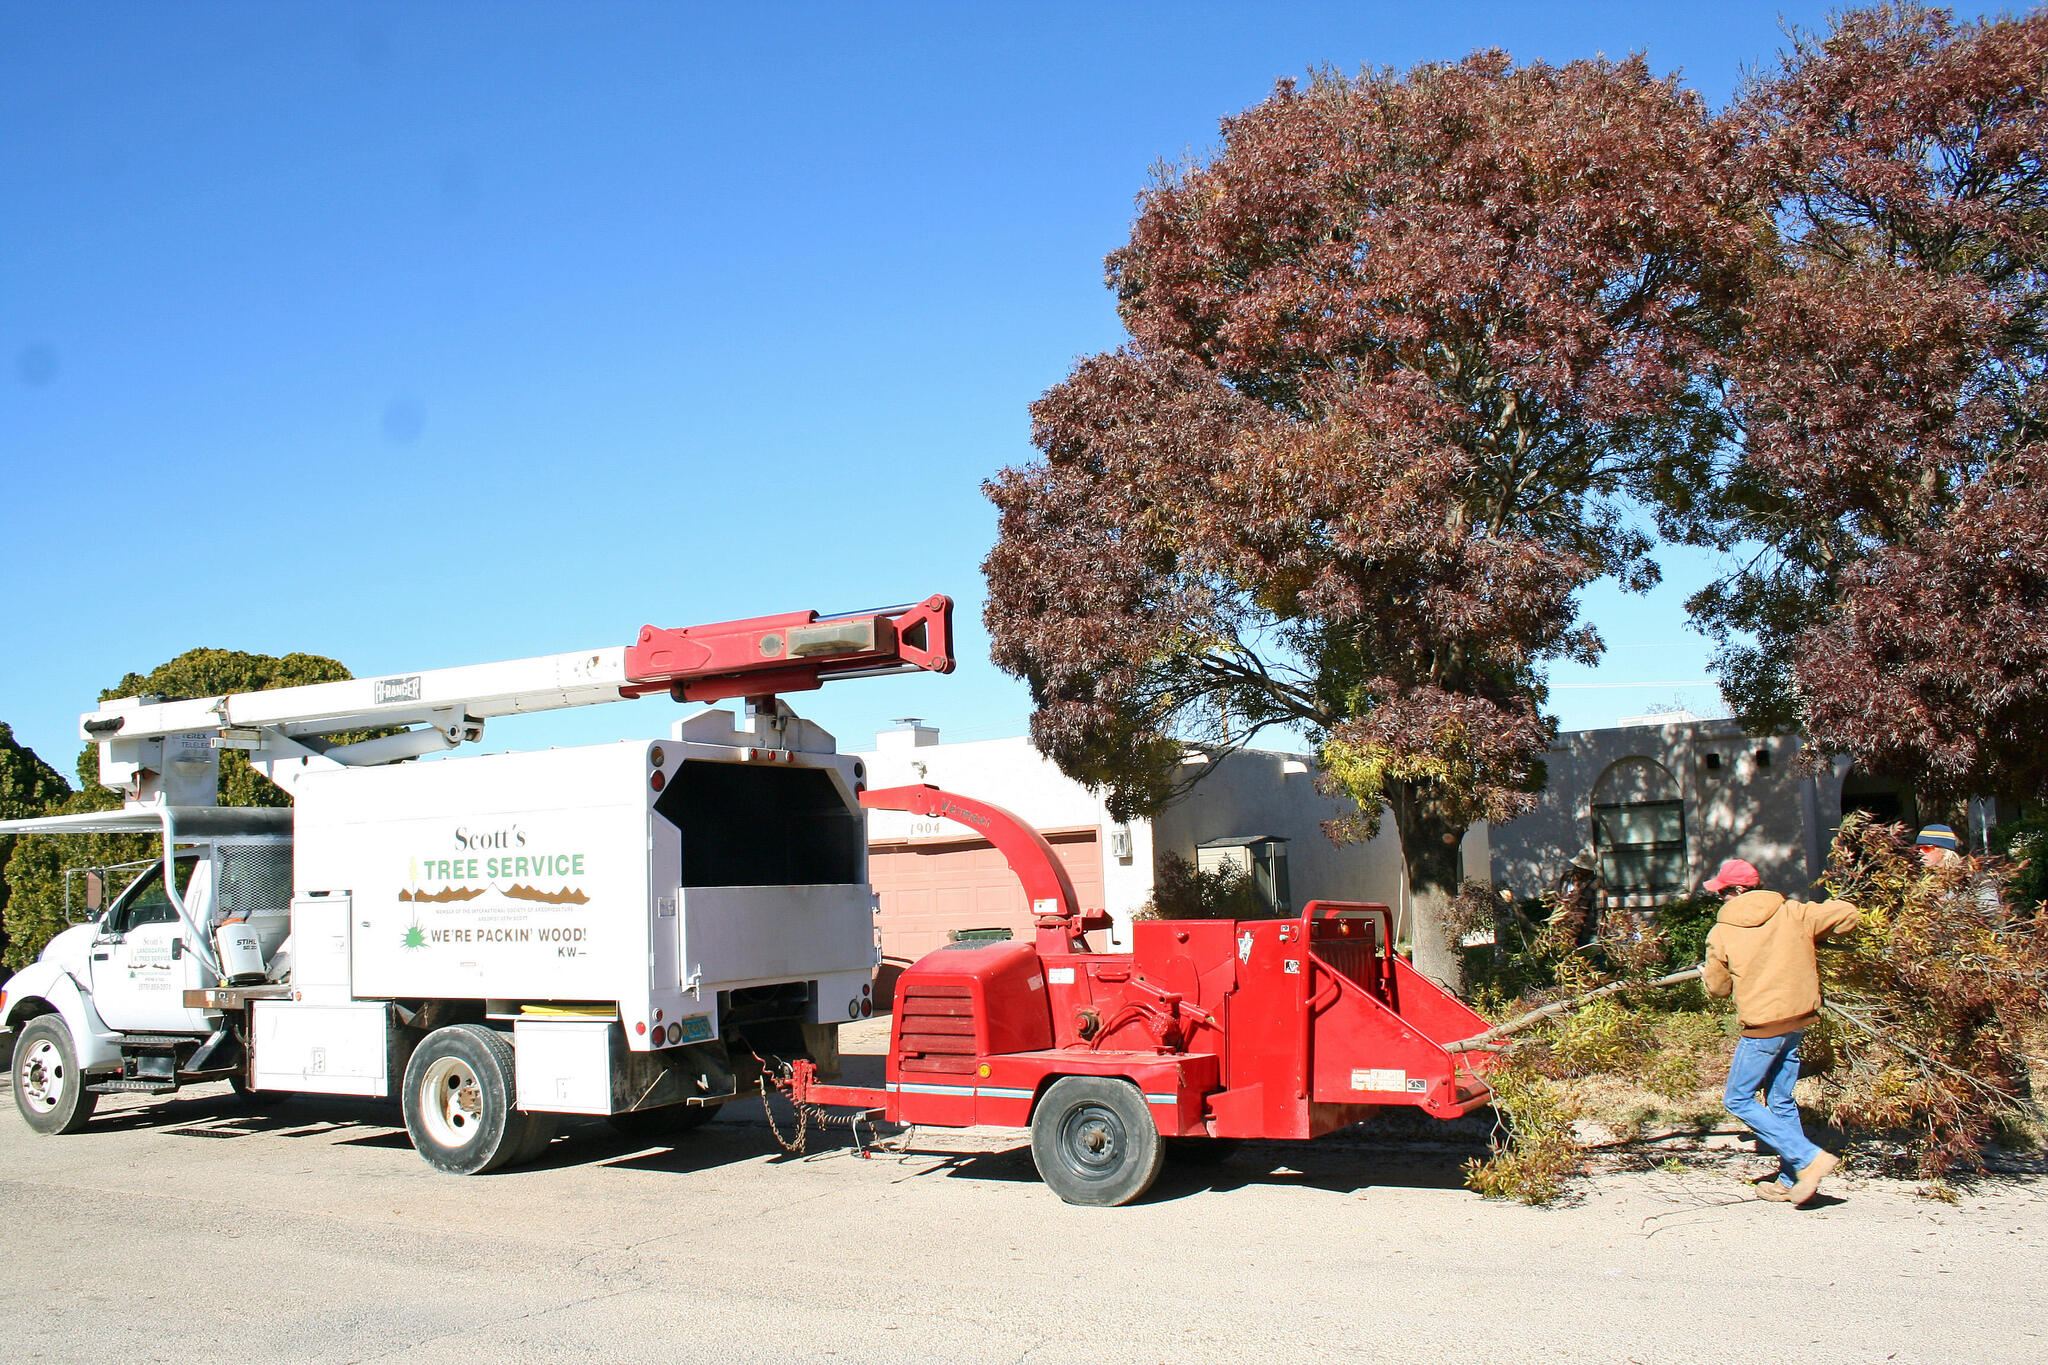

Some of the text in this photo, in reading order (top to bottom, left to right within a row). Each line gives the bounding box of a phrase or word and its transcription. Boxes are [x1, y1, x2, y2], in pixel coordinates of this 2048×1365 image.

[455, 824, 526, 852] Scott's
[910, 822, 940, 835] 1904
[424, 854, 585, 880] TREE SERVICE
[431, 928, 587, 943] WE'RE PACKIN' WOOD!
